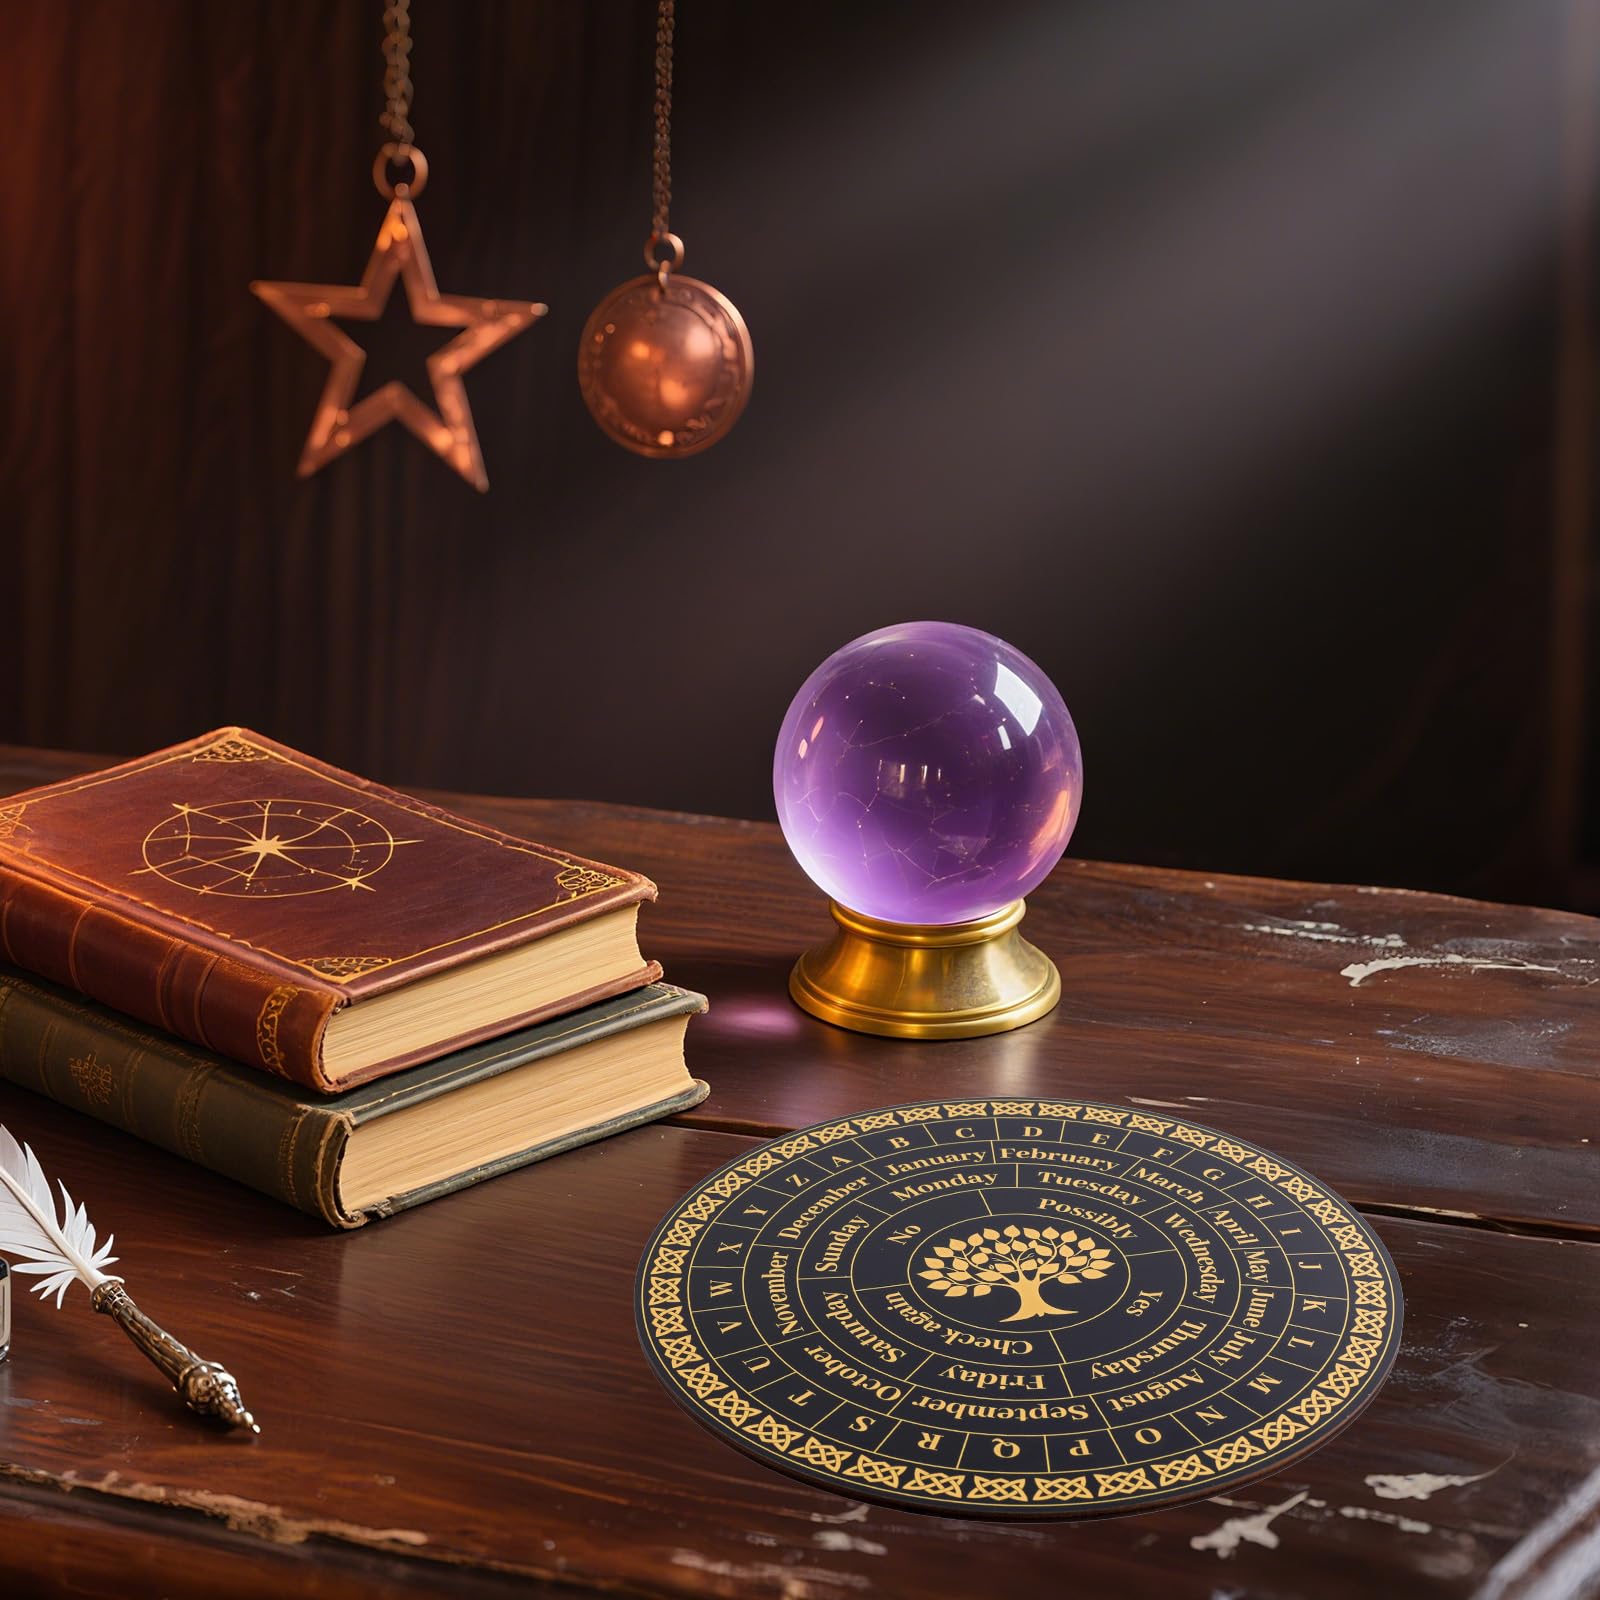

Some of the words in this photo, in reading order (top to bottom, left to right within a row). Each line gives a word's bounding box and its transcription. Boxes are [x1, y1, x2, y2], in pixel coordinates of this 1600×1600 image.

[889, 1136, 911, 1149] B
[954, 1127, 976, 1139] C
[1023, 1125, 1044, 1138] D
[1090, 1132, 1111, 1145] E
[831, 1155, 852, 1167] A
[886, 1149, 987, 1176] January
[999, 1147, 1120, 1172] February
[1151, 1147, 1173, 1160] F
[785, 1174, 810, 1188] Z
[1132, 1166, 1204, 1205] March
[1202, 1167, 1226, 1182] G
[890, 1172, 998, 1202] Monday
[1037, 1171, 1146, 1206] Tuesday
[742, 1205, 769, 1216] Y
[777, 1175, 871, 1240] December
[1245, 1194, 1273, 1210] H
[1037, 1197, 1138, 1240] Possibly
[1208, 1208, 1258, 1246] April
[887, 1223, 922, 1246] No
[1279, 1228, 1302, 1237] I
[716, 1241, 743, 1255] X
[815, 1215, 869, 1273] Sunday
[1164, 1212, 1225, 1304] Wednesday
[1244, 1250, 1269, 1283] May
[1298, 1261, 1322, 1270] J
[709, 1279, 734, 1298] W
[760, 1251, 804, 1336] November
[885, 1291, 940, 1332] again
[1126, 1290, 1164, 1316] Yes
[1242, 1287, 1275, 1328] June
[1303, 1298, 1327, 1311] K
[717, 1321, 743, 1334] V
[822, 1291, 908, 1364] Saturday
[939, 1326, 1033, 1356] Check
[1091, 1319, 1207, 1380] Thursday
[1208, 1330, 1256, 1366] July
[1287, 1336, 1314, 1348] L
[742, 1356, 771, 1374] U
[803, 1344, 902, 1402] October
[938, 1364, 1046, 1390] Friday
[1247, 1373, 1282, 1395] M
[787, 1389, 816, 1407] T
[1106, 1368, 1205, 1412] August
[911, 1395, 1091, 1422] September
[1194, 1405, 1227, 1425] N
[848, 1415, 876, 1433] S
[917, 1431, 944, 1451] R
[1134, 1427, 1163, 1445] O
[991, 1437, 1022, 1459] Q
[1069, 1439, 1092, 1457] P
